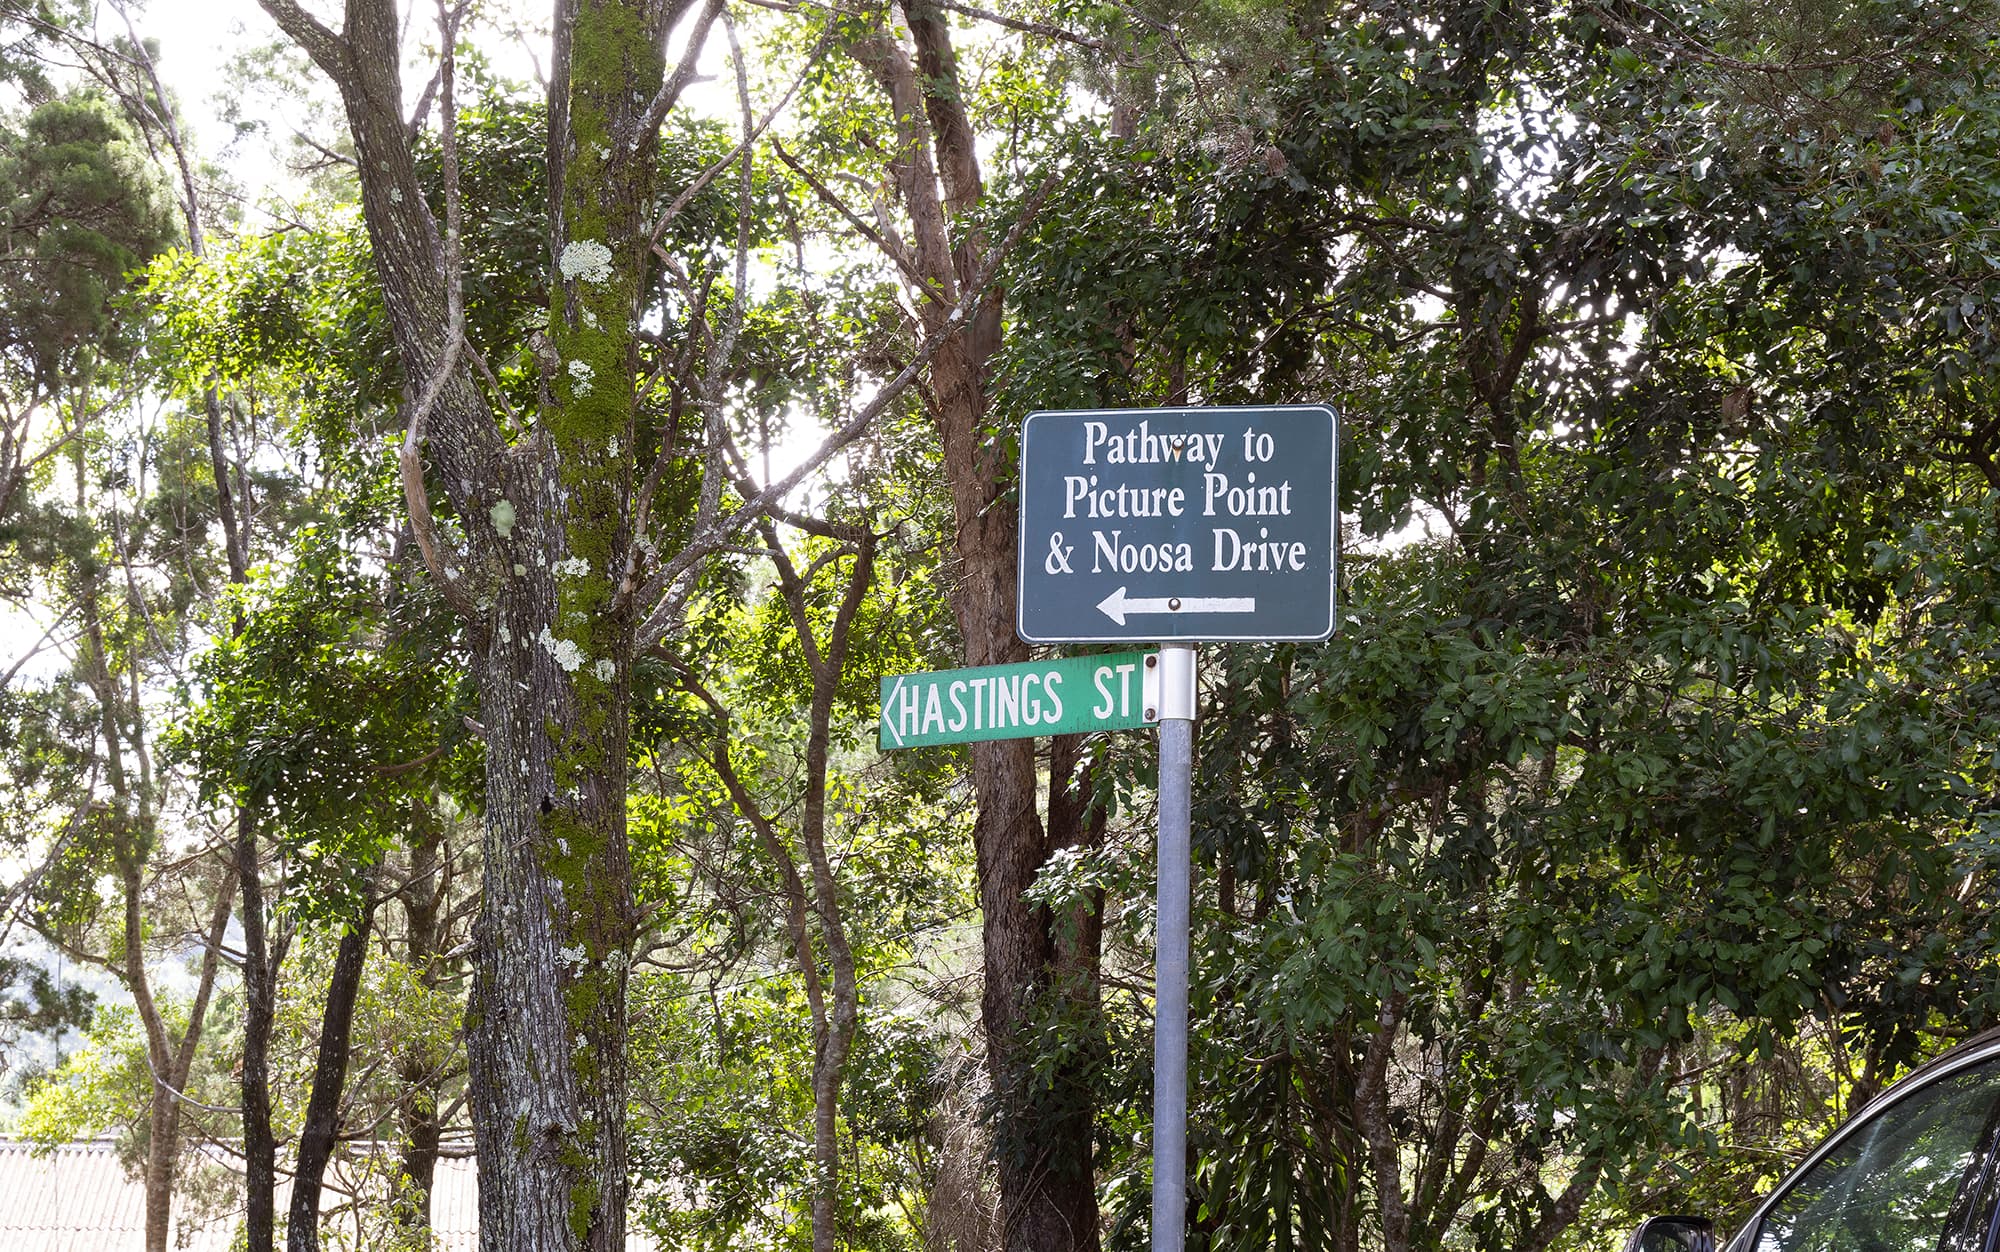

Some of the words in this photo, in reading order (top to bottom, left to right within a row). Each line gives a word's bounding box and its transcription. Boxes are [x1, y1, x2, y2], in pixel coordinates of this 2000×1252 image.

[1083, 420, 1225, 472] Pathway
[1243, 426, 1274, 462] to
[1063, 475, 1185, 518] Picture
[1202, 472, 1292, 516] Point
[1044, 531, 1074, 575] &
[1092, 530, 1193, 573] Noosa
[1211, 527, 1306, 572] Drive
[900, 671, 1063, 737] HASTINGS
[1093, 664, 1135, 720] ST
